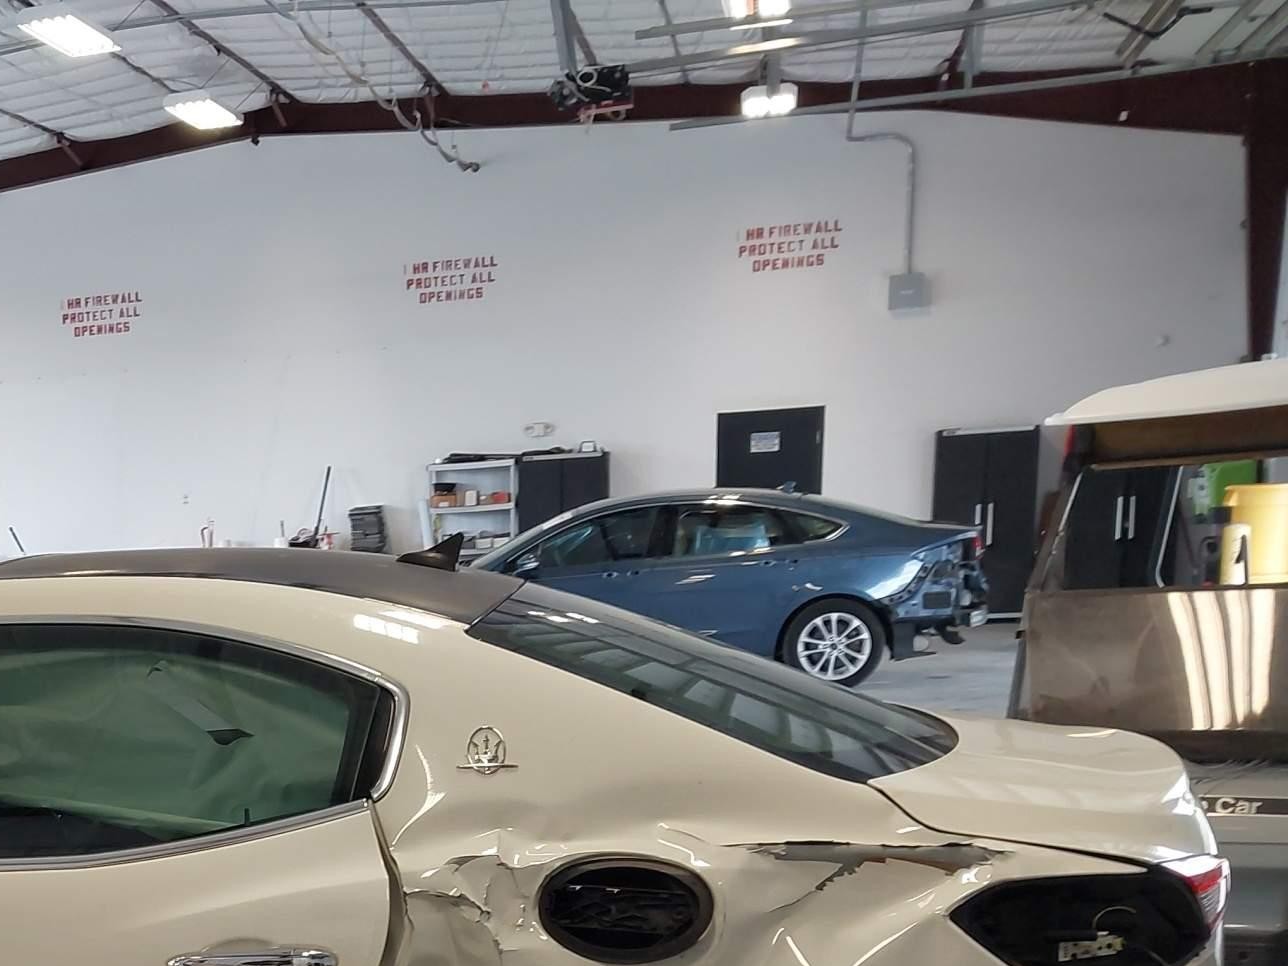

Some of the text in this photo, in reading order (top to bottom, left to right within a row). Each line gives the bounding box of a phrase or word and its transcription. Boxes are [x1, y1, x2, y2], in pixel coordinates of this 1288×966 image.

[745, 227, 765, 242] HR
[768, 219, 843, 239] FIREWALL
[738, 236, 840, 259] PROTECT ALL
[412, 261, 429, 275] HR
[432, 255, 499, 273] FIREWALL
[752, 253, 825, 273] OPENINGS
[406, 271, 496, 291] PROTECT ALL
[66, 291, 143, 310] HR FIREWALL
[419, 286, 484, 304] OPENINGS
[61, 306, 141, 325] PROTECT ALL
[73, 321, 131, 338] OPENINGS
[1214, 797, 1264, 814] Car
